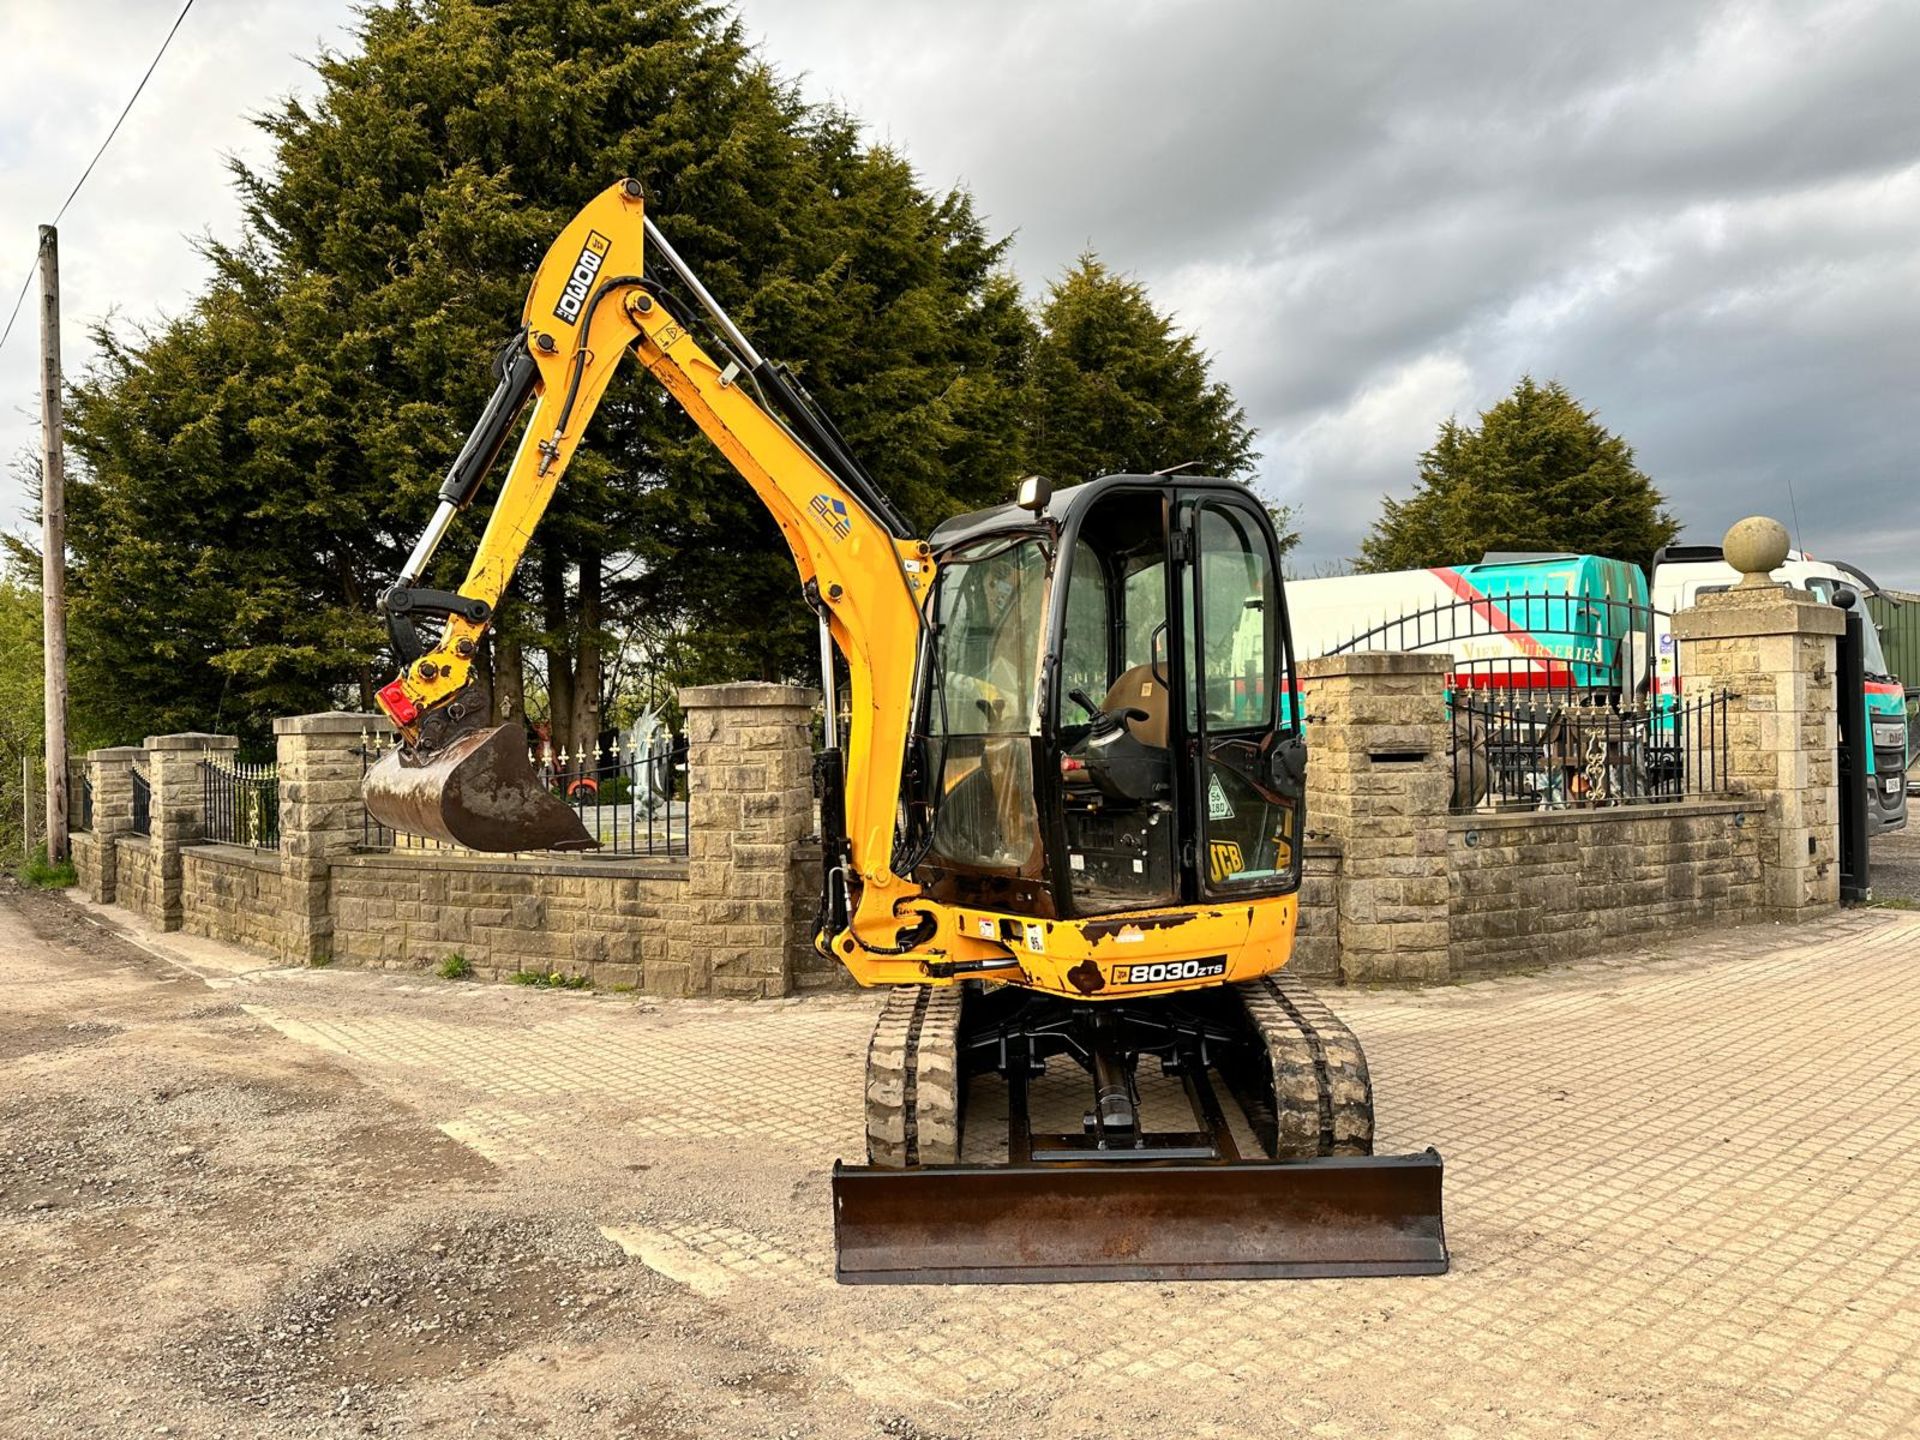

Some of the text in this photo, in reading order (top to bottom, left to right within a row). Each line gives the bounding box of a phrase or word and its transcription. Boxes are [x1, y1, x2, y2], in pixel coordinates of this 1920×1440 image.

[810, 496, 850, 540] BCE
[1510, 638, 1602, 663] NURSERIES
[1209, 844, 1242, 885] JCB
